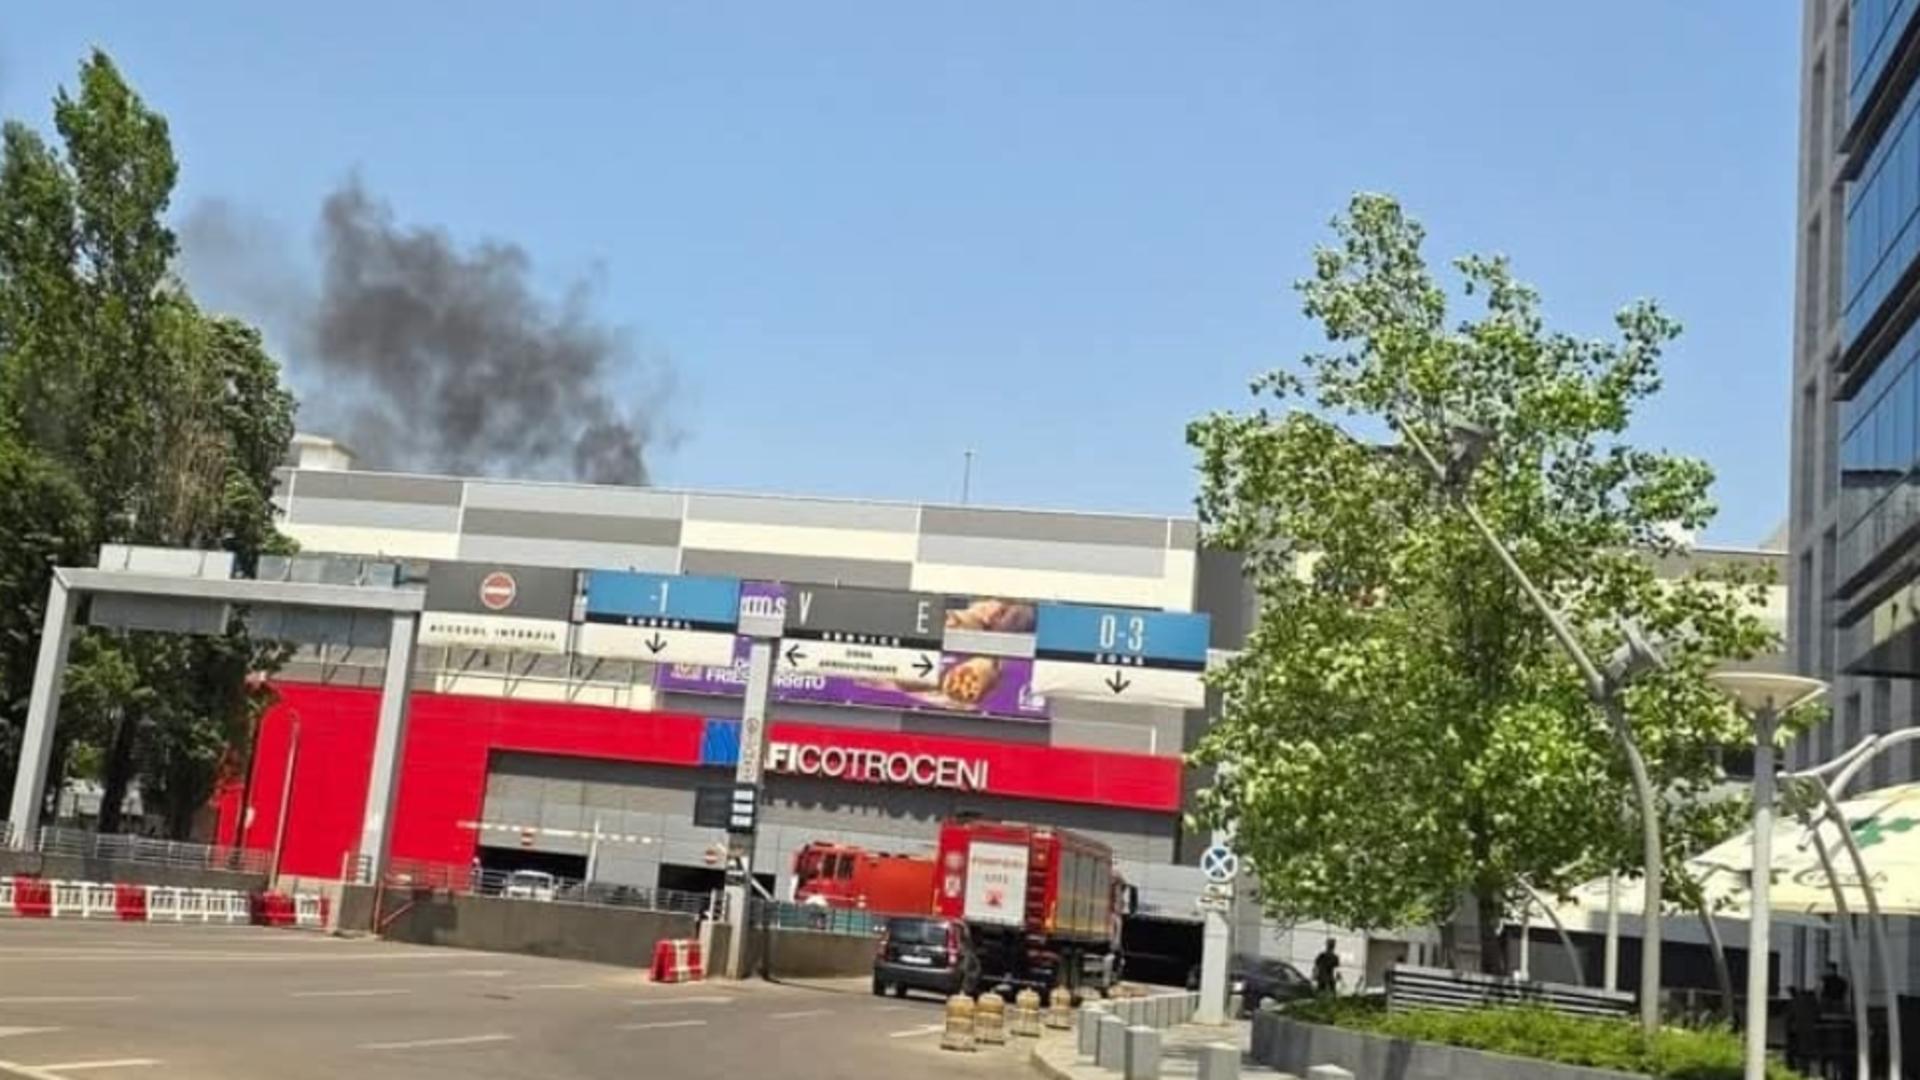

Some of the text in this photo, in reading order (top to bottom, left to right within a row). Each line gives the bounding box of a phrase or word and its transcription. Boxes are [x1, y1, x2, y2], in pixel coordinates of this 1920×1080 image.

[650, 580, 669, 613] -1
[799, 591, 812, 625] V
[916, 601, 930, 634] E
[1100, 614, 1144, 651] 0-3
